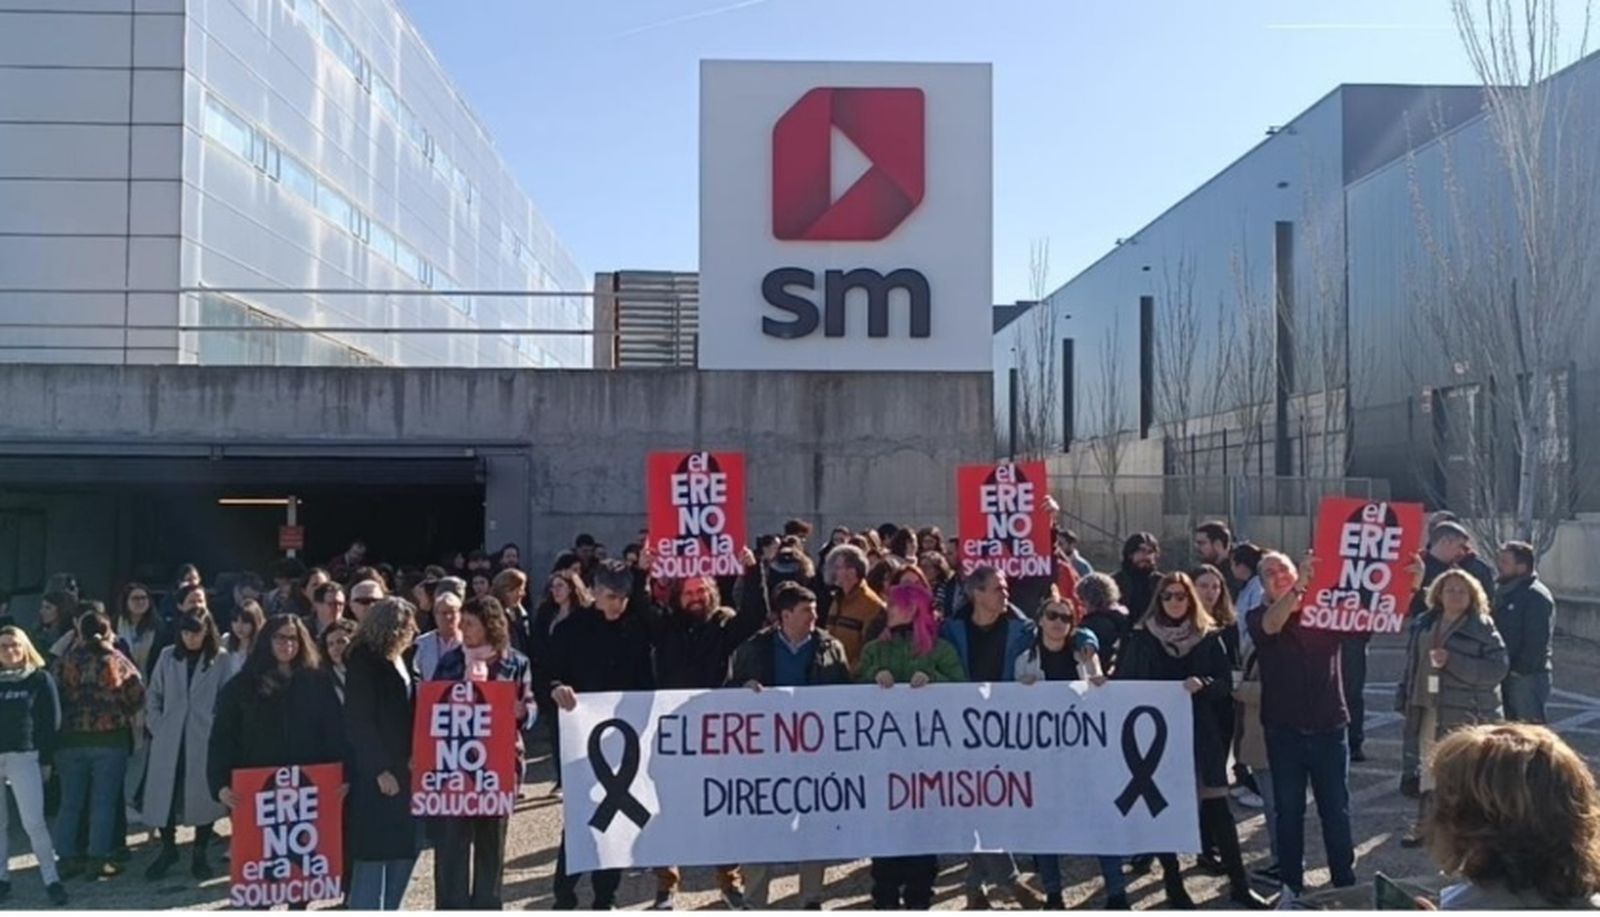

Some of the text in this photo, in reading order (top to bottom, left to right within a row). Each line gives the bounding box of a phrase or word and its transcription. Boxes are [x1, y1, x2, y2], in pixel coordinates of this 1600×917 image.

[761, 266, 931, 339] sm
[688, 452, 708, 472] el
[995, 463, 1016, 483] el
[671, 472, 727, 506] ERE
[980, 482, 1034, 513] ERE
[678, 505, 726, 535] NO
[987, 513, 1032, 539] NO
[1362, 502, 1387, 523] el
[658, 534, 734, 556] era la
[963, 539, 1034, 556] era la
[1339, 523, 1403, 560] ERE
[1339, 559, 1391, 592] NO
[1316, 588, 1396, 614] era la
[451, 681, 473, 702] el
[430, 703, 492, 737] ERE
[775, 712, 824, 752] NO
[834, 711, 906, 751] ERA
[915, 709, 951, 747] LA
[962, 704, 1107, 749] SOLUCIÓN
[436, 740, 487, 771] NO
[275, 765, 300, 787] el
[421, 769, 499, 792] era la
[703, 764, 1033, 817] DIRECCIÓN DIMISIÓN
[255, 786, 319, 827] ERE
[264, 822, 318, 859] NO
[243, 854, 329, 881] era la
